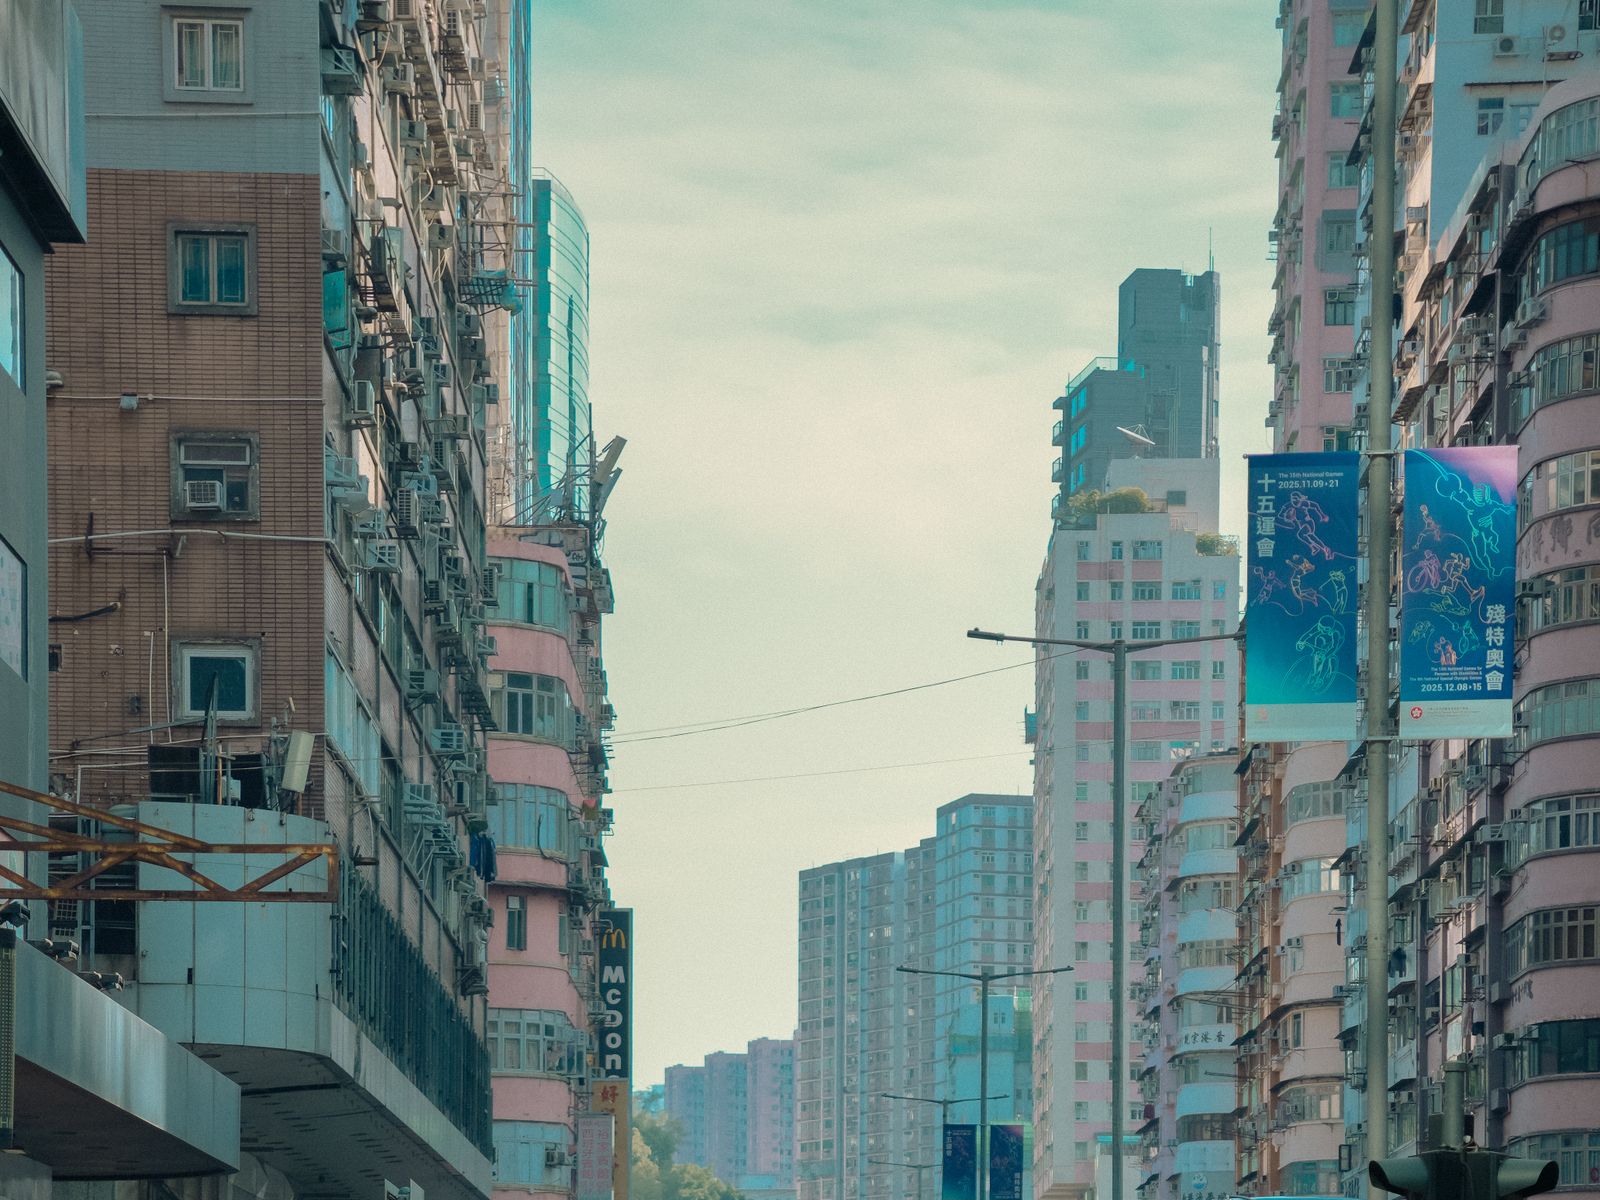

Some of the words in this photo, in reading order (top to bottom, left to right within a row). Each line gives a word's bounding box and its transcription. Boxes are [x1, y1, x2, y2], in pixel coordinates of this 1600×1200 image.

[1256, 473, 1276, 558] 十五運會
[1485, 604, 1505, 691] 殘特奧會
[602, 965, 625, 1080] McDon
